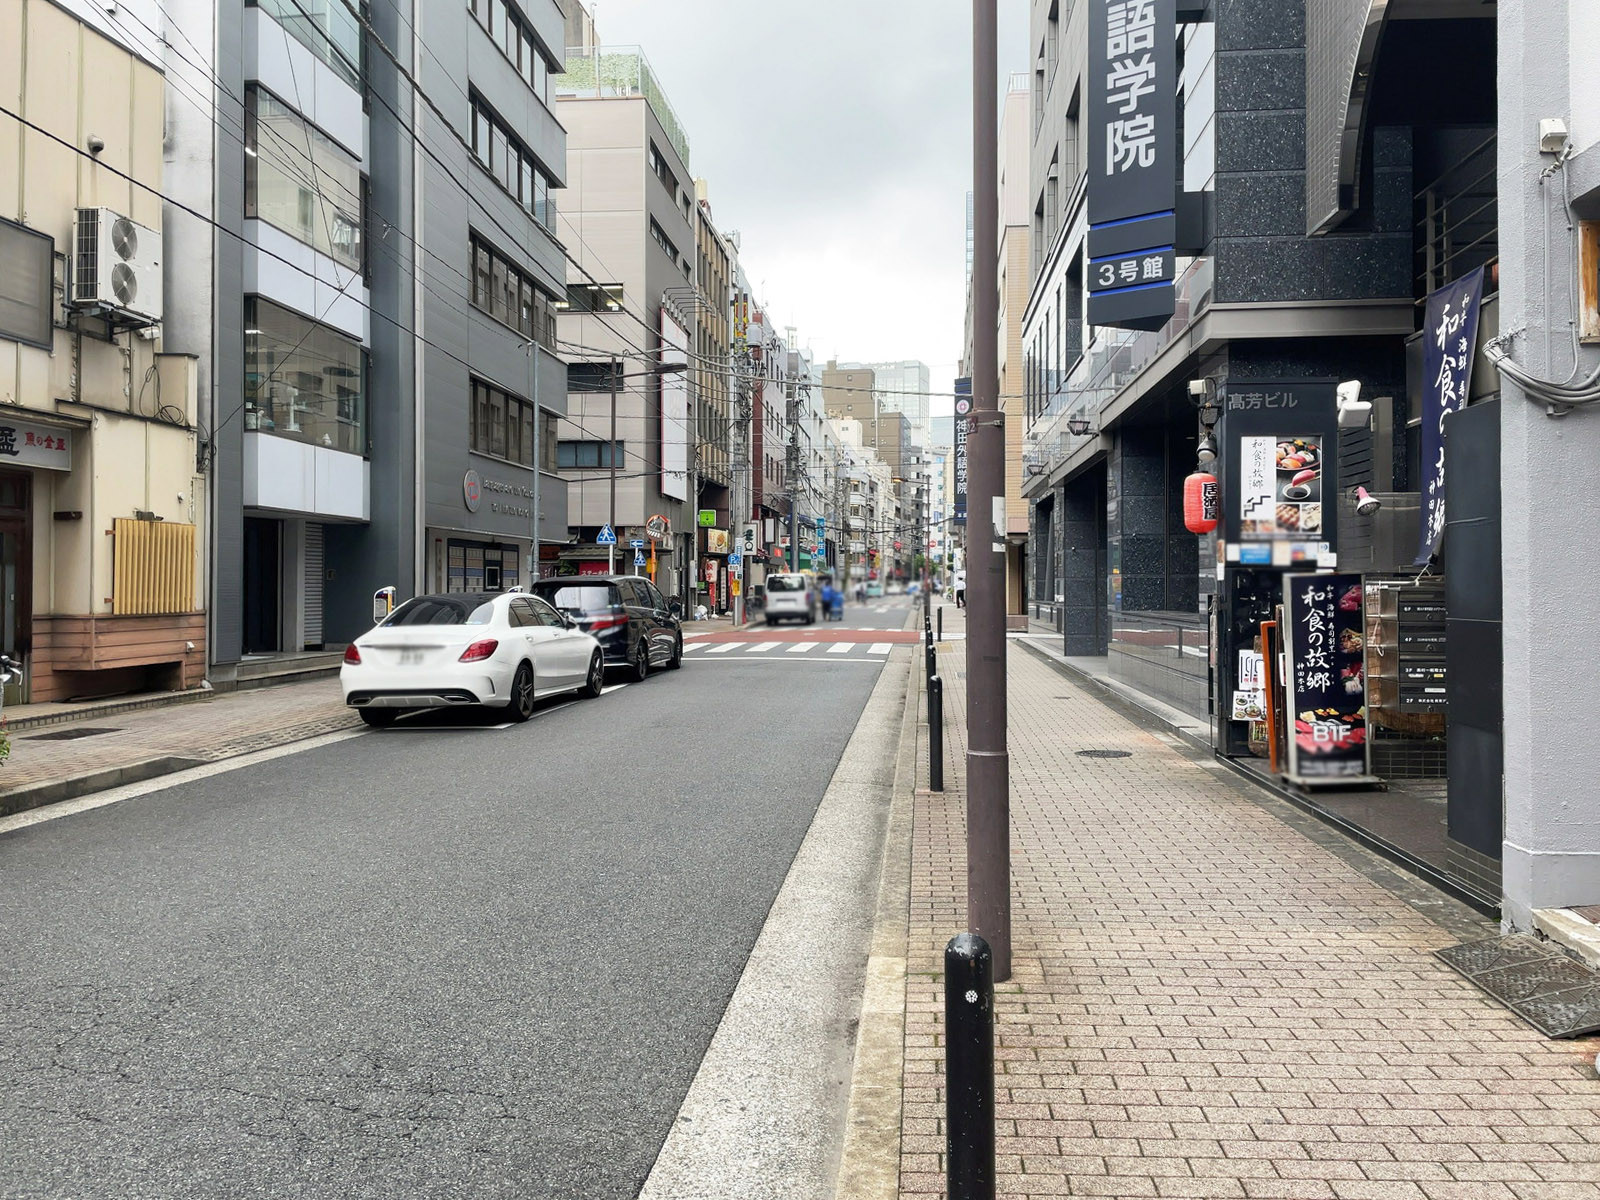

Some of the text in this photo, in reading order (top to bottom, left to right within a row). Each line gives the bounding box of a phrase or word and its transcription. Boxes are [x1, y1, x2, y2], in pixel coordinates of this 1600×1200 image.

[1098, 256, 1163, 286] 3号館
[1203, 483, 1217, 520] 居酒屋
[1301, 585, 1331, 694] 和食の故郷
[1297, 663, 1305, 693] 神田本店
[1313, 724, 1352, 742] B1F
